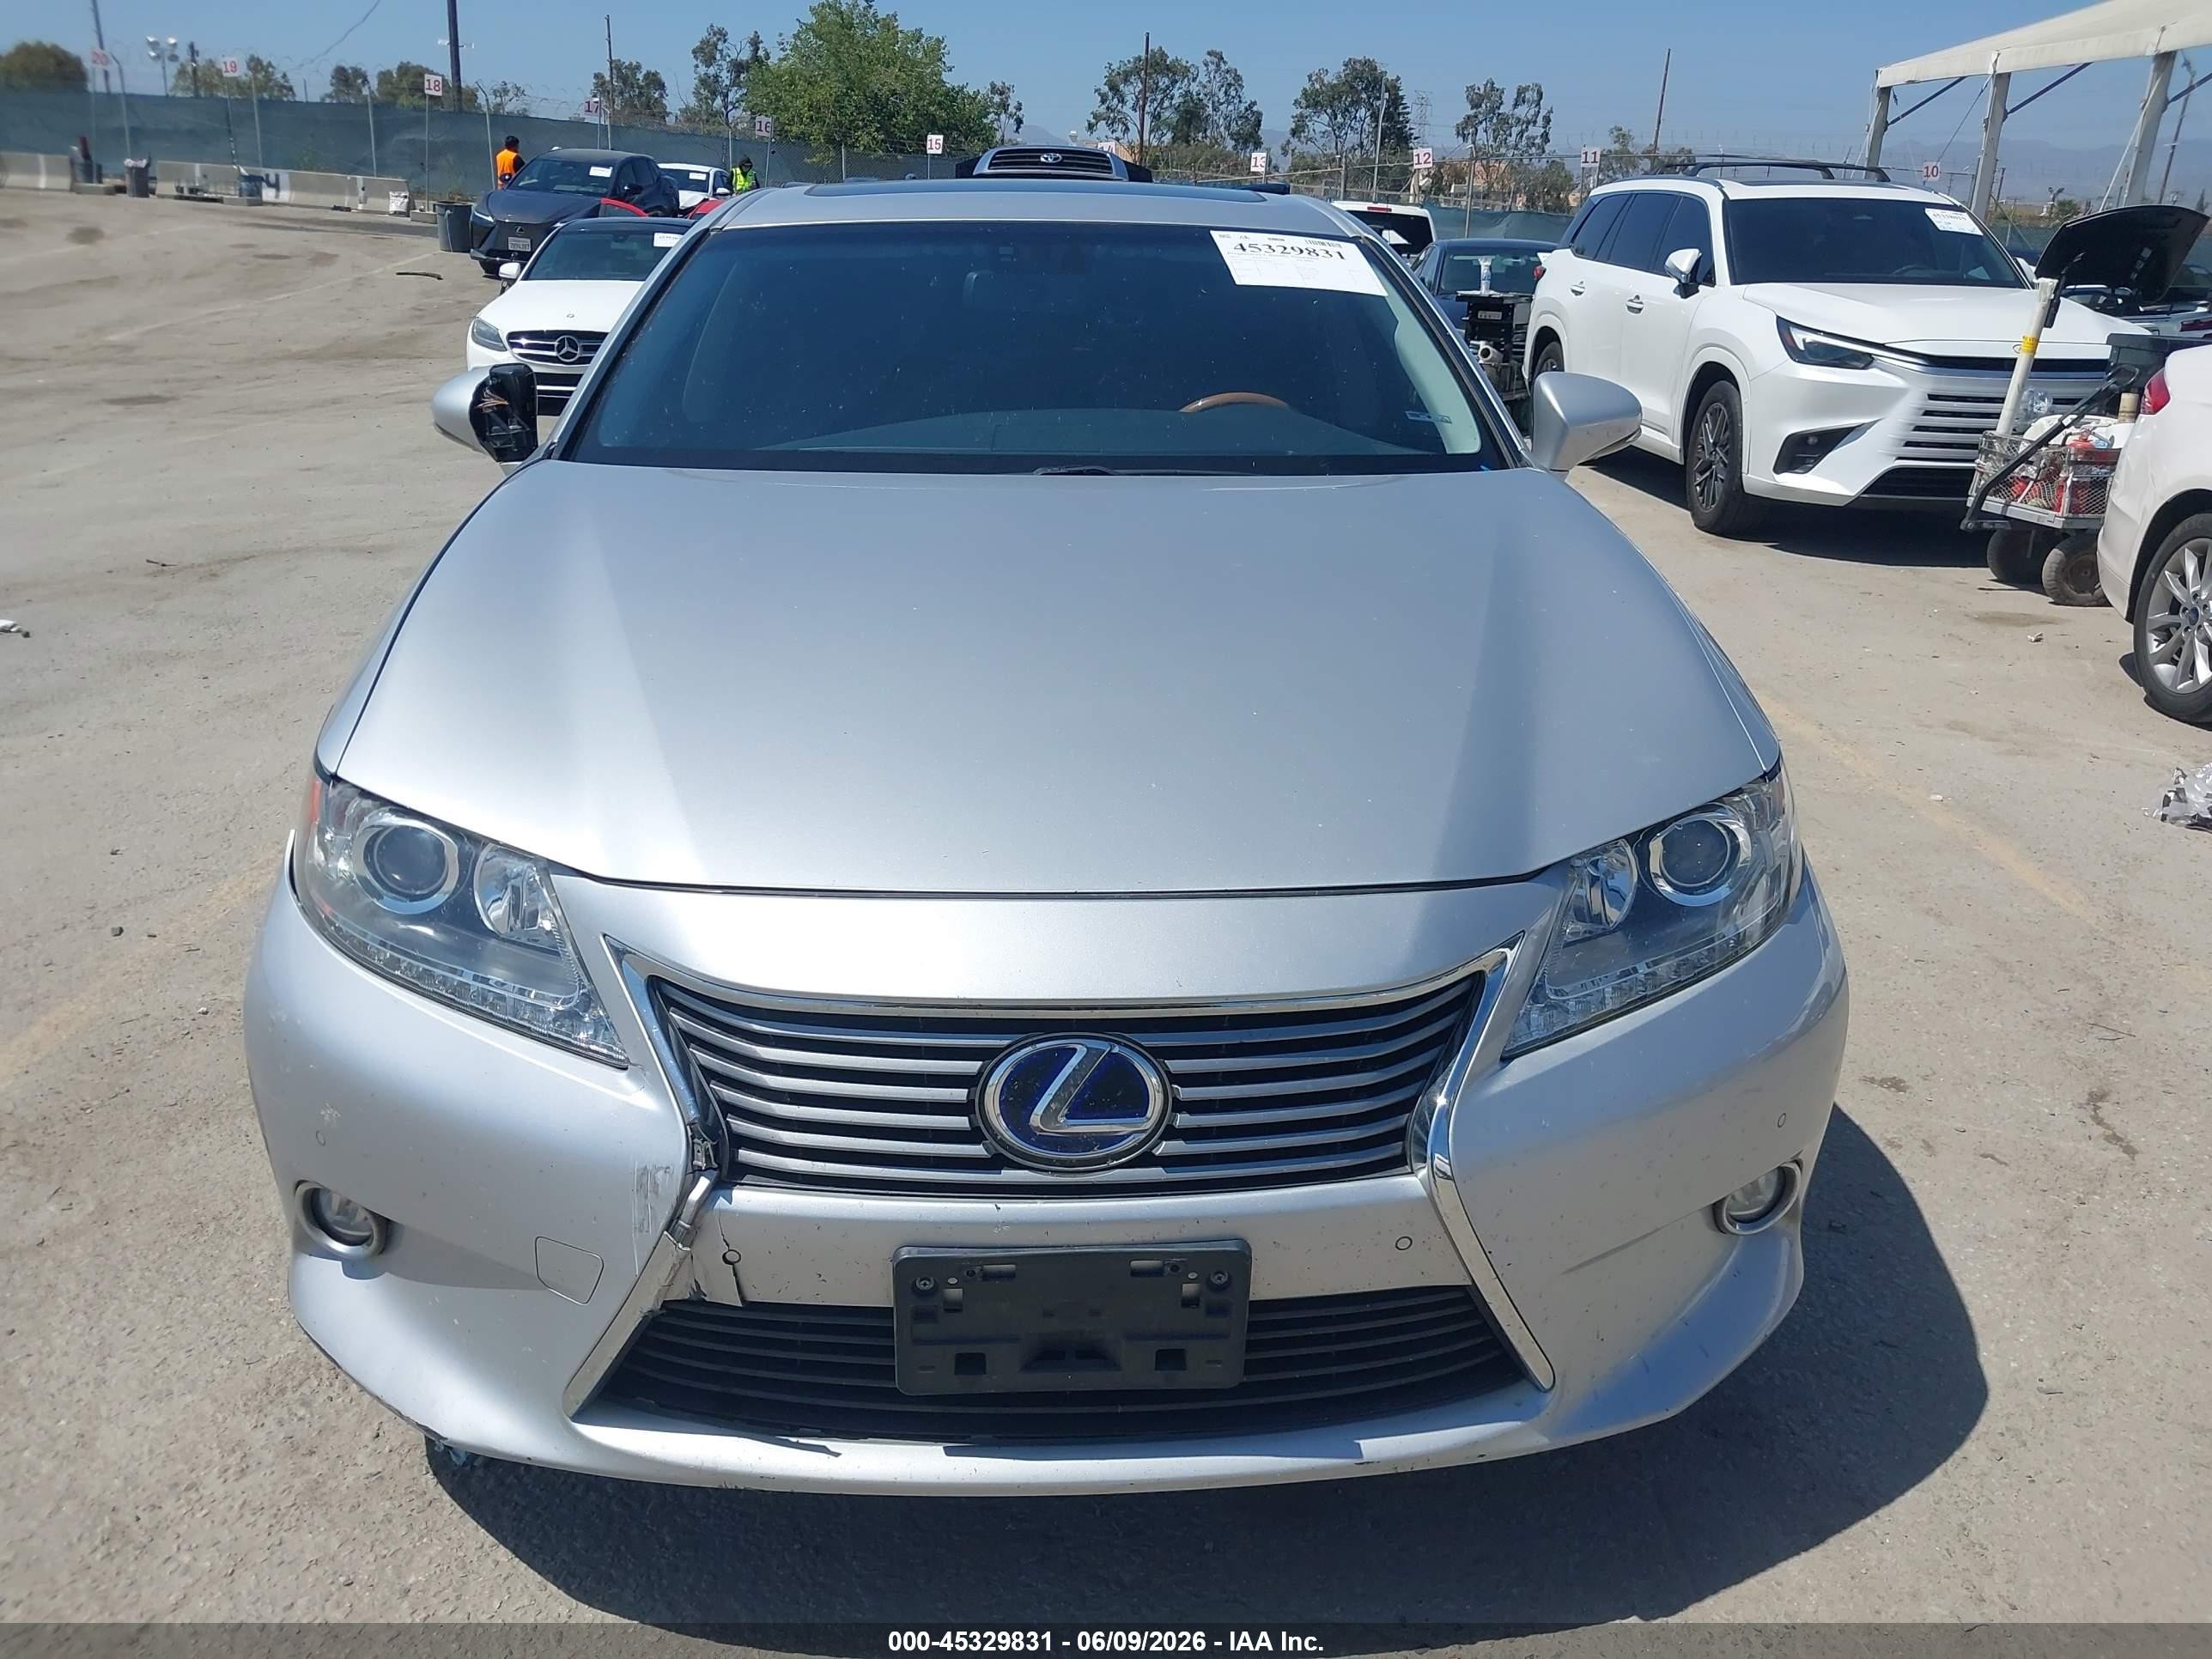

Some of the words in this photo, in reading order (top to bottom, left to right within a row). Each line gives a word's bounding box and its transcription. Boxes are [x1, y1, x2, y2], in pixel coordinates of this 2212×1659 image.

[223, 60, 237, 73] 19
[425, 78, 441, 92] 18
[584, 100, 599, 113] 17
[927, 138, 941, 150] 15
[1414, 152, 1431, 166] 12
[1582, 150, 1598, 164] 11
[1923, 165, 1939, 178] 10
[1233, 242, 1346, 260] 45329831
